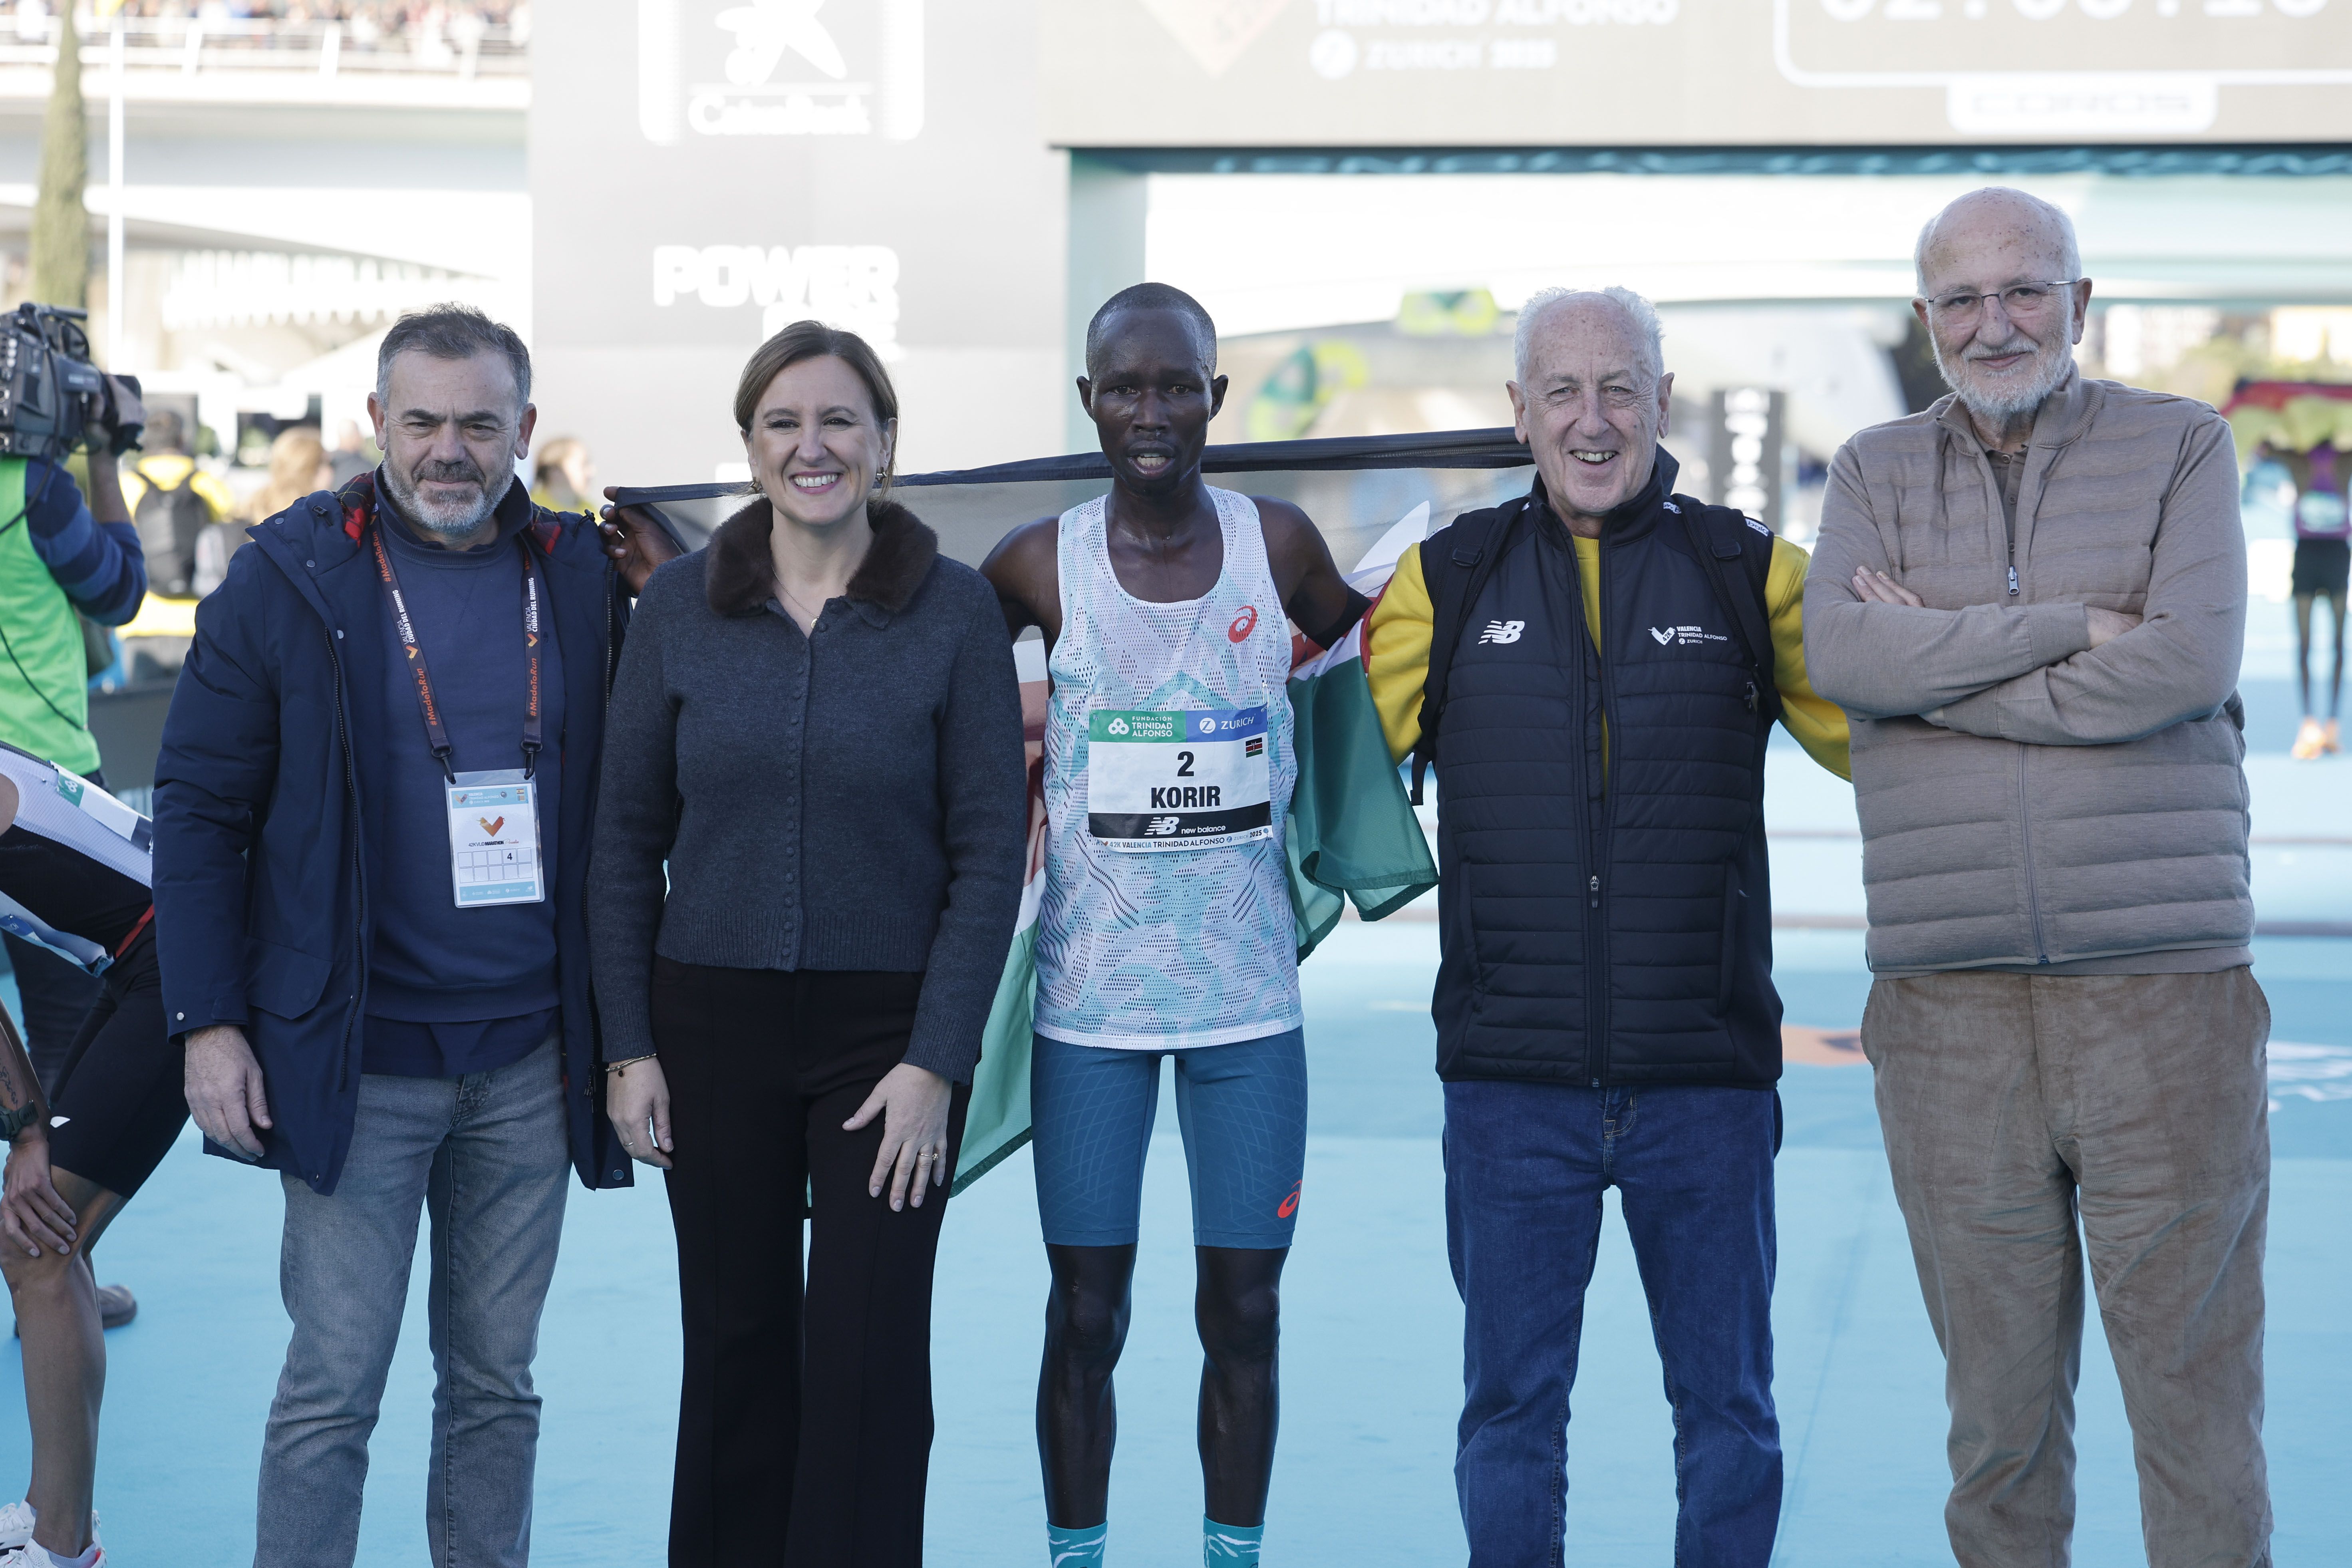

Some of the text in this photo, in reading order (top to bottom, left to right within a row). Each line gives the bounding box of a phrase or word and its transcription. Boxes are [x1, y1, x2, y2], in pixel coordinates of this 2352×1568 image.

[654, 245, 900, 307] POWER
[373, 531, 391, 582] #MadeToRun
[393, 590, 405, 613] RUNNING
[397, 620, 409, 644] VALENCIA
[404, 623, 415, 642] CIUDAD
[1662, 631, 1672, 641] 42K
[417, 668, 438, 725] #MadeToRun
[1221, 716, 1254, 729] ZURICH
[1177, 751, 1194, 777] 2
[1151, 786, 1220, 808] KORIR
[1190, 837, 1225, 846] ALFONSO
